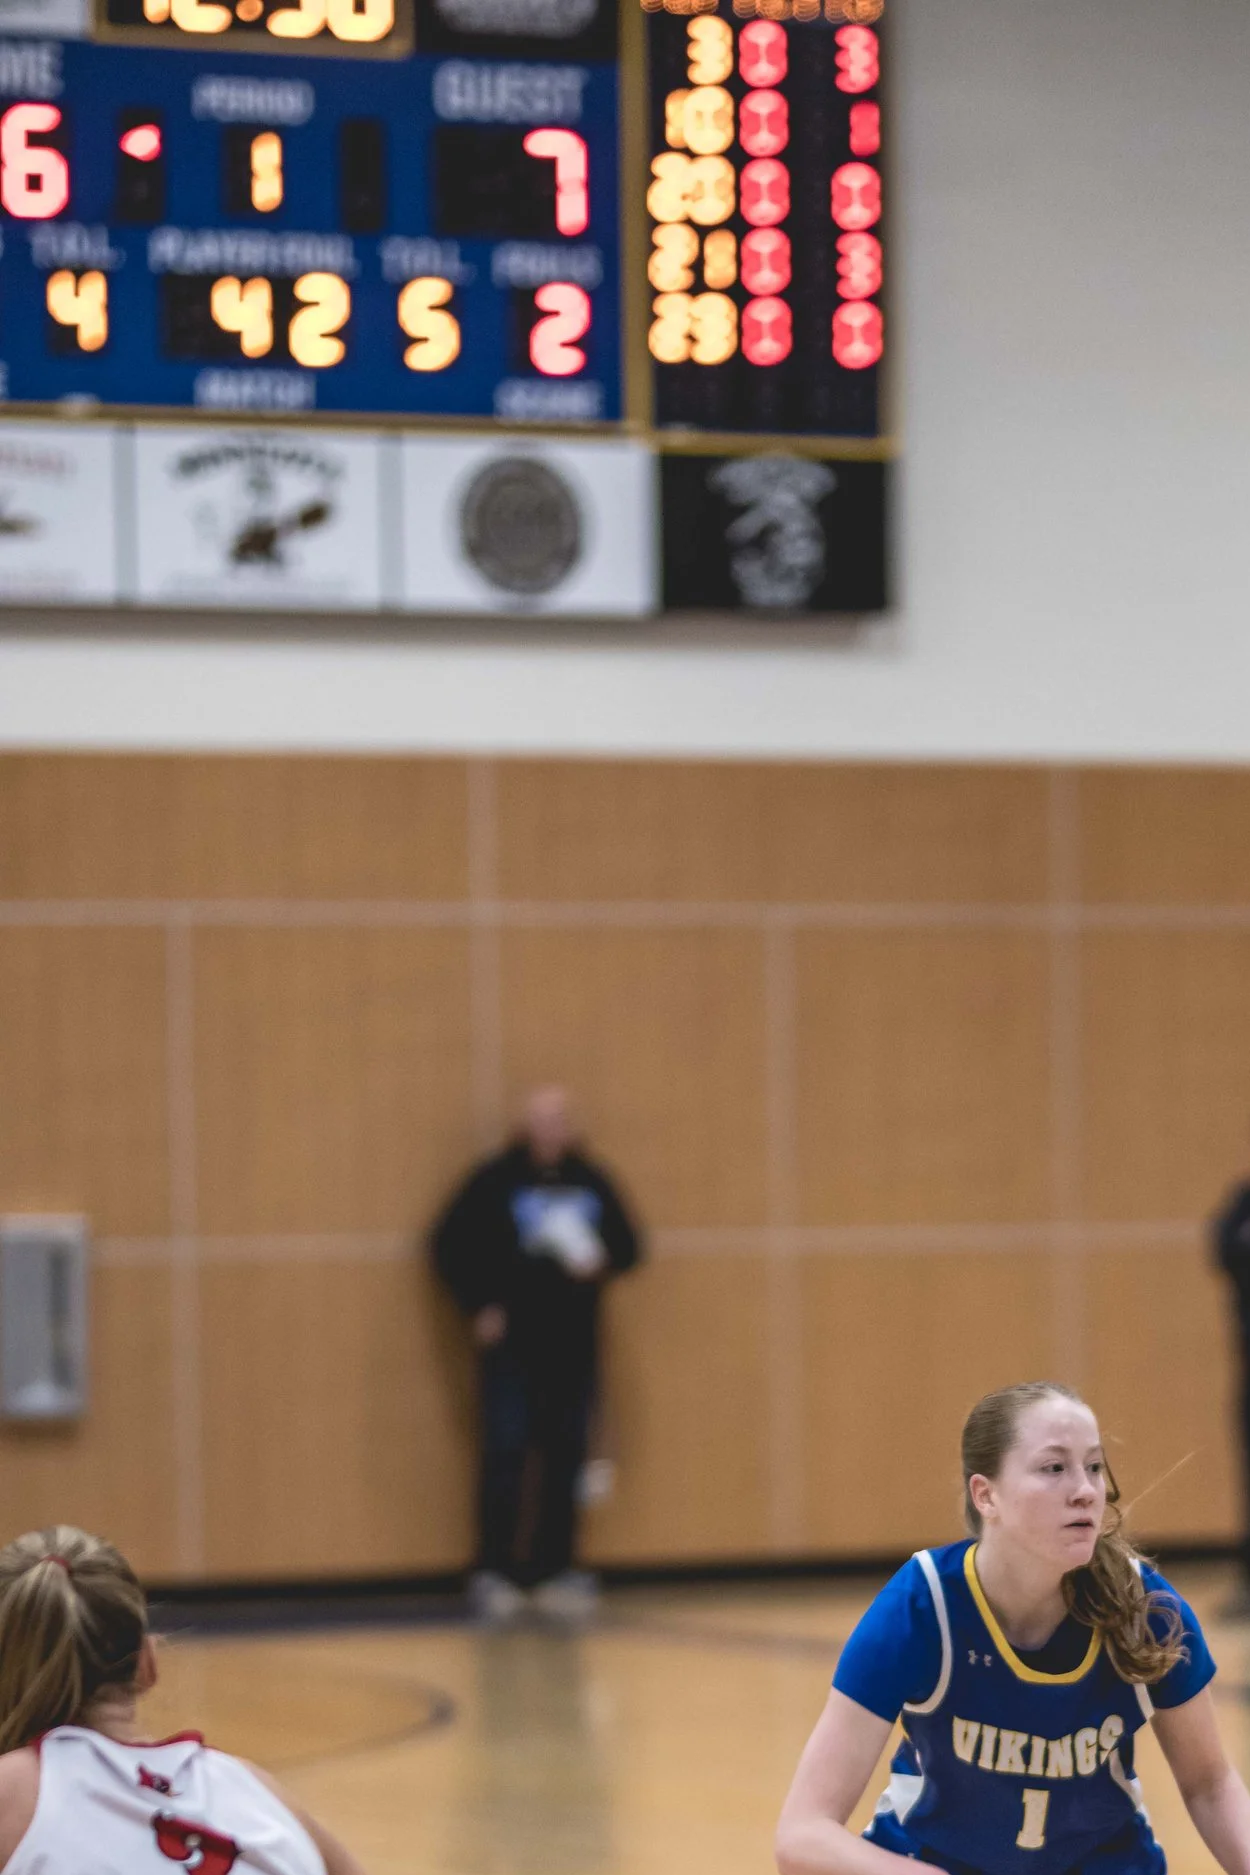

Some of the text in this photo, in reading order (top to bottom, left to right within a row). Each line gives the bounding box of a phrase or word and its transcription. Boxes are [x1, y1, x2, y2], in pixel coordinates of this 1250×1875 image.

[0, 102, 69, 219] 6
[250, 131, 283, 213] 1
[523, 128, 589, 236] 7
[46, 269, 108, 352] 4
[210, 271, 351, 367] 42
[529, 281, 591, 376] 2
[951, 1713, 1125, 1779] VIKINGS
[1015, 1787, 1050, 1848] 1
